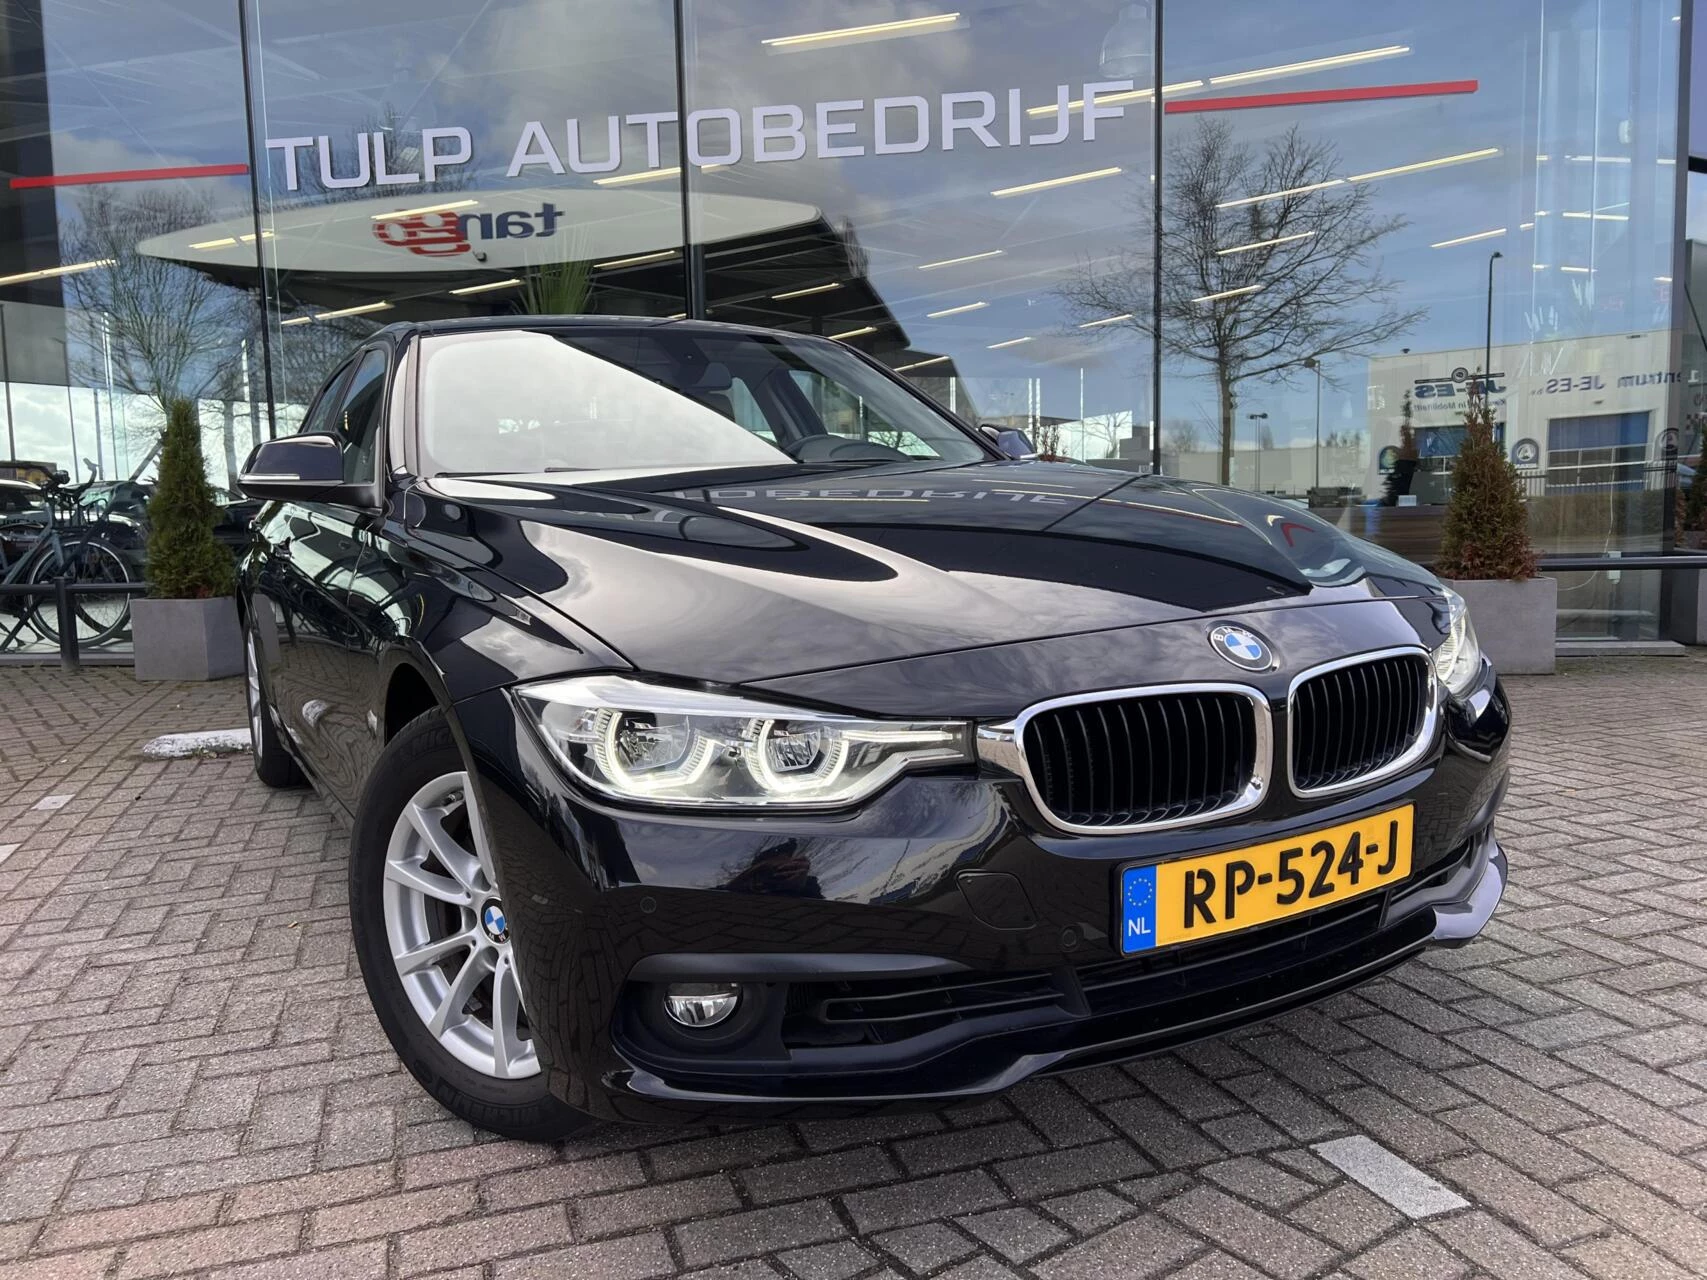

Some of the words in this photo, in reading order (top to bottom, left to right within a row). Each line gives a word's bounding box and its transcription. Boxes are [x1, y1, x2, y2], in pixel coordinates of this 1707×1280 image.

[265, 126, 474, 191] TULP
[506, 80, 1134, 177] AUTOBEDRIJF
[1127, 917, 1151, 937] NL
[1183, 820, 1399, 929] RP-524-J
